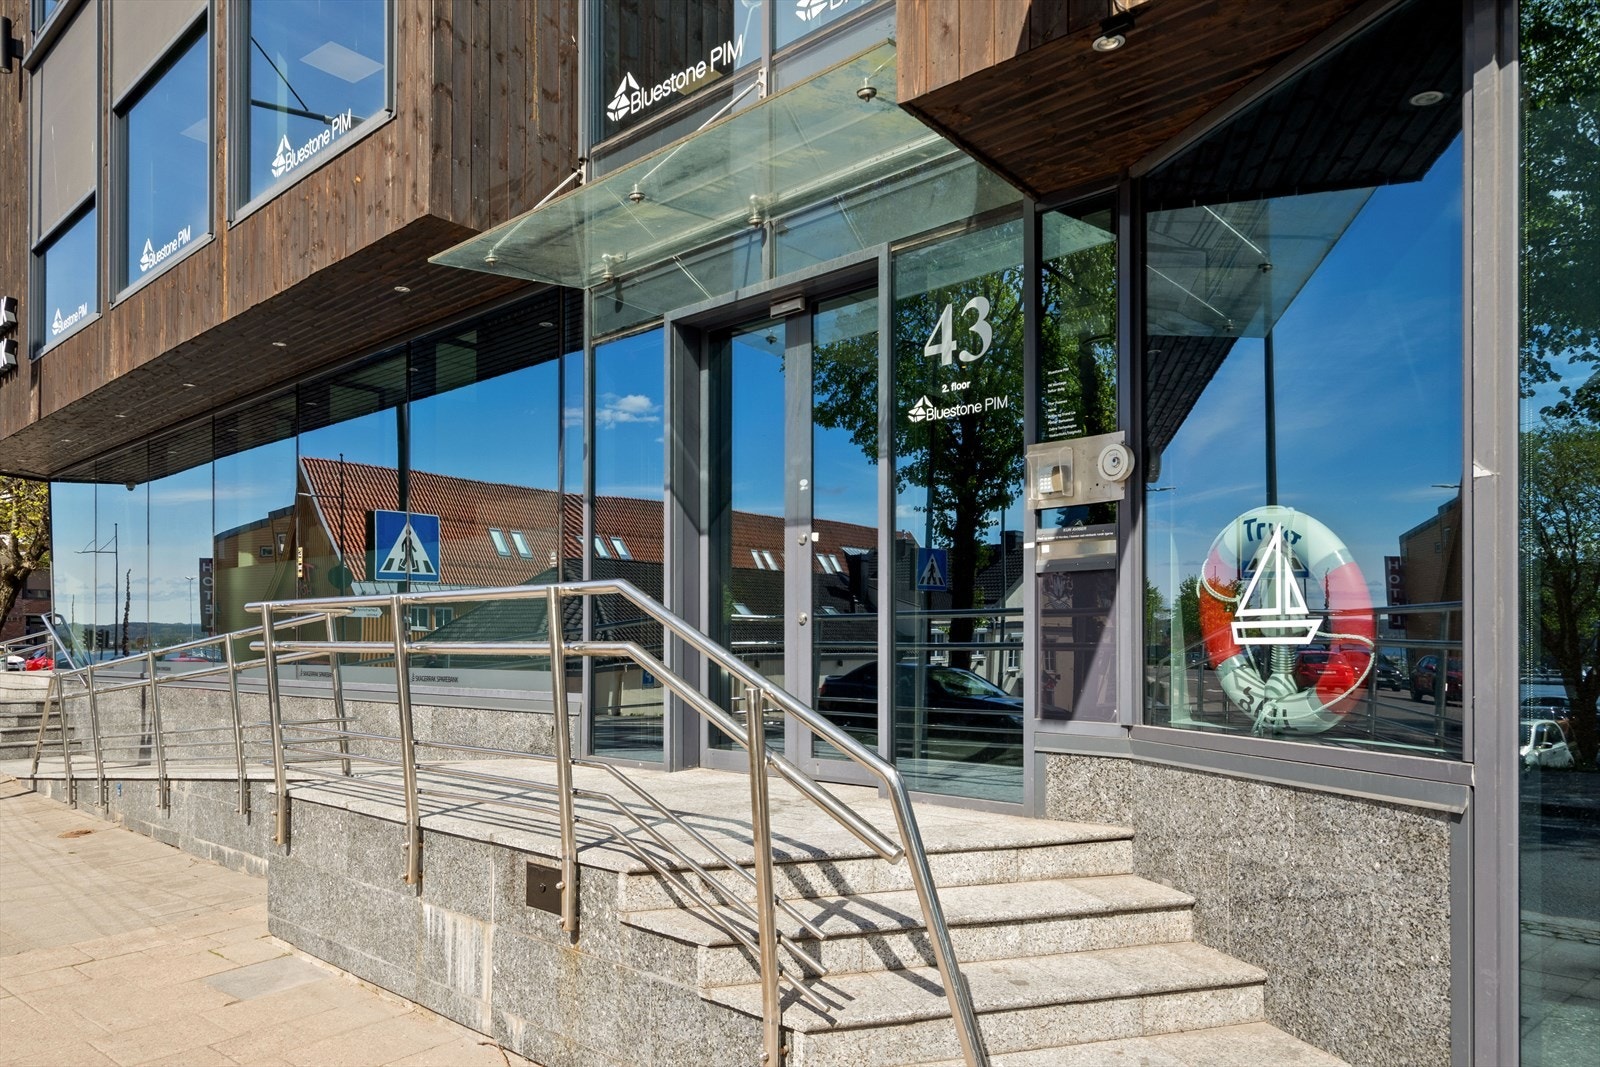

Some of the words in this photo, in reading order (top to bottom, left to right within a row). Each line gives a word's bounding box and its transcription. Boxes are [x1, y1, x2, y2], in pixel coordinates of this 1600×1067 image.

[630, 60, 707, 115] Bluestone
[710, 33, 743, 73] PIM
[285, 129, 331, 172] Bluestone
[331, 107, 352, 140] PIM
[148, 239, 178, 269] Bluestone
[177, 224, 191, 248] PIM
[924, 296, 993, 366] 43
[926, 402, 982, 421] Bluestone
[985, 395, 1008, 412] PIM
[941, 384, 950, 393] 2.
[951, 381, 971, 391] floor
